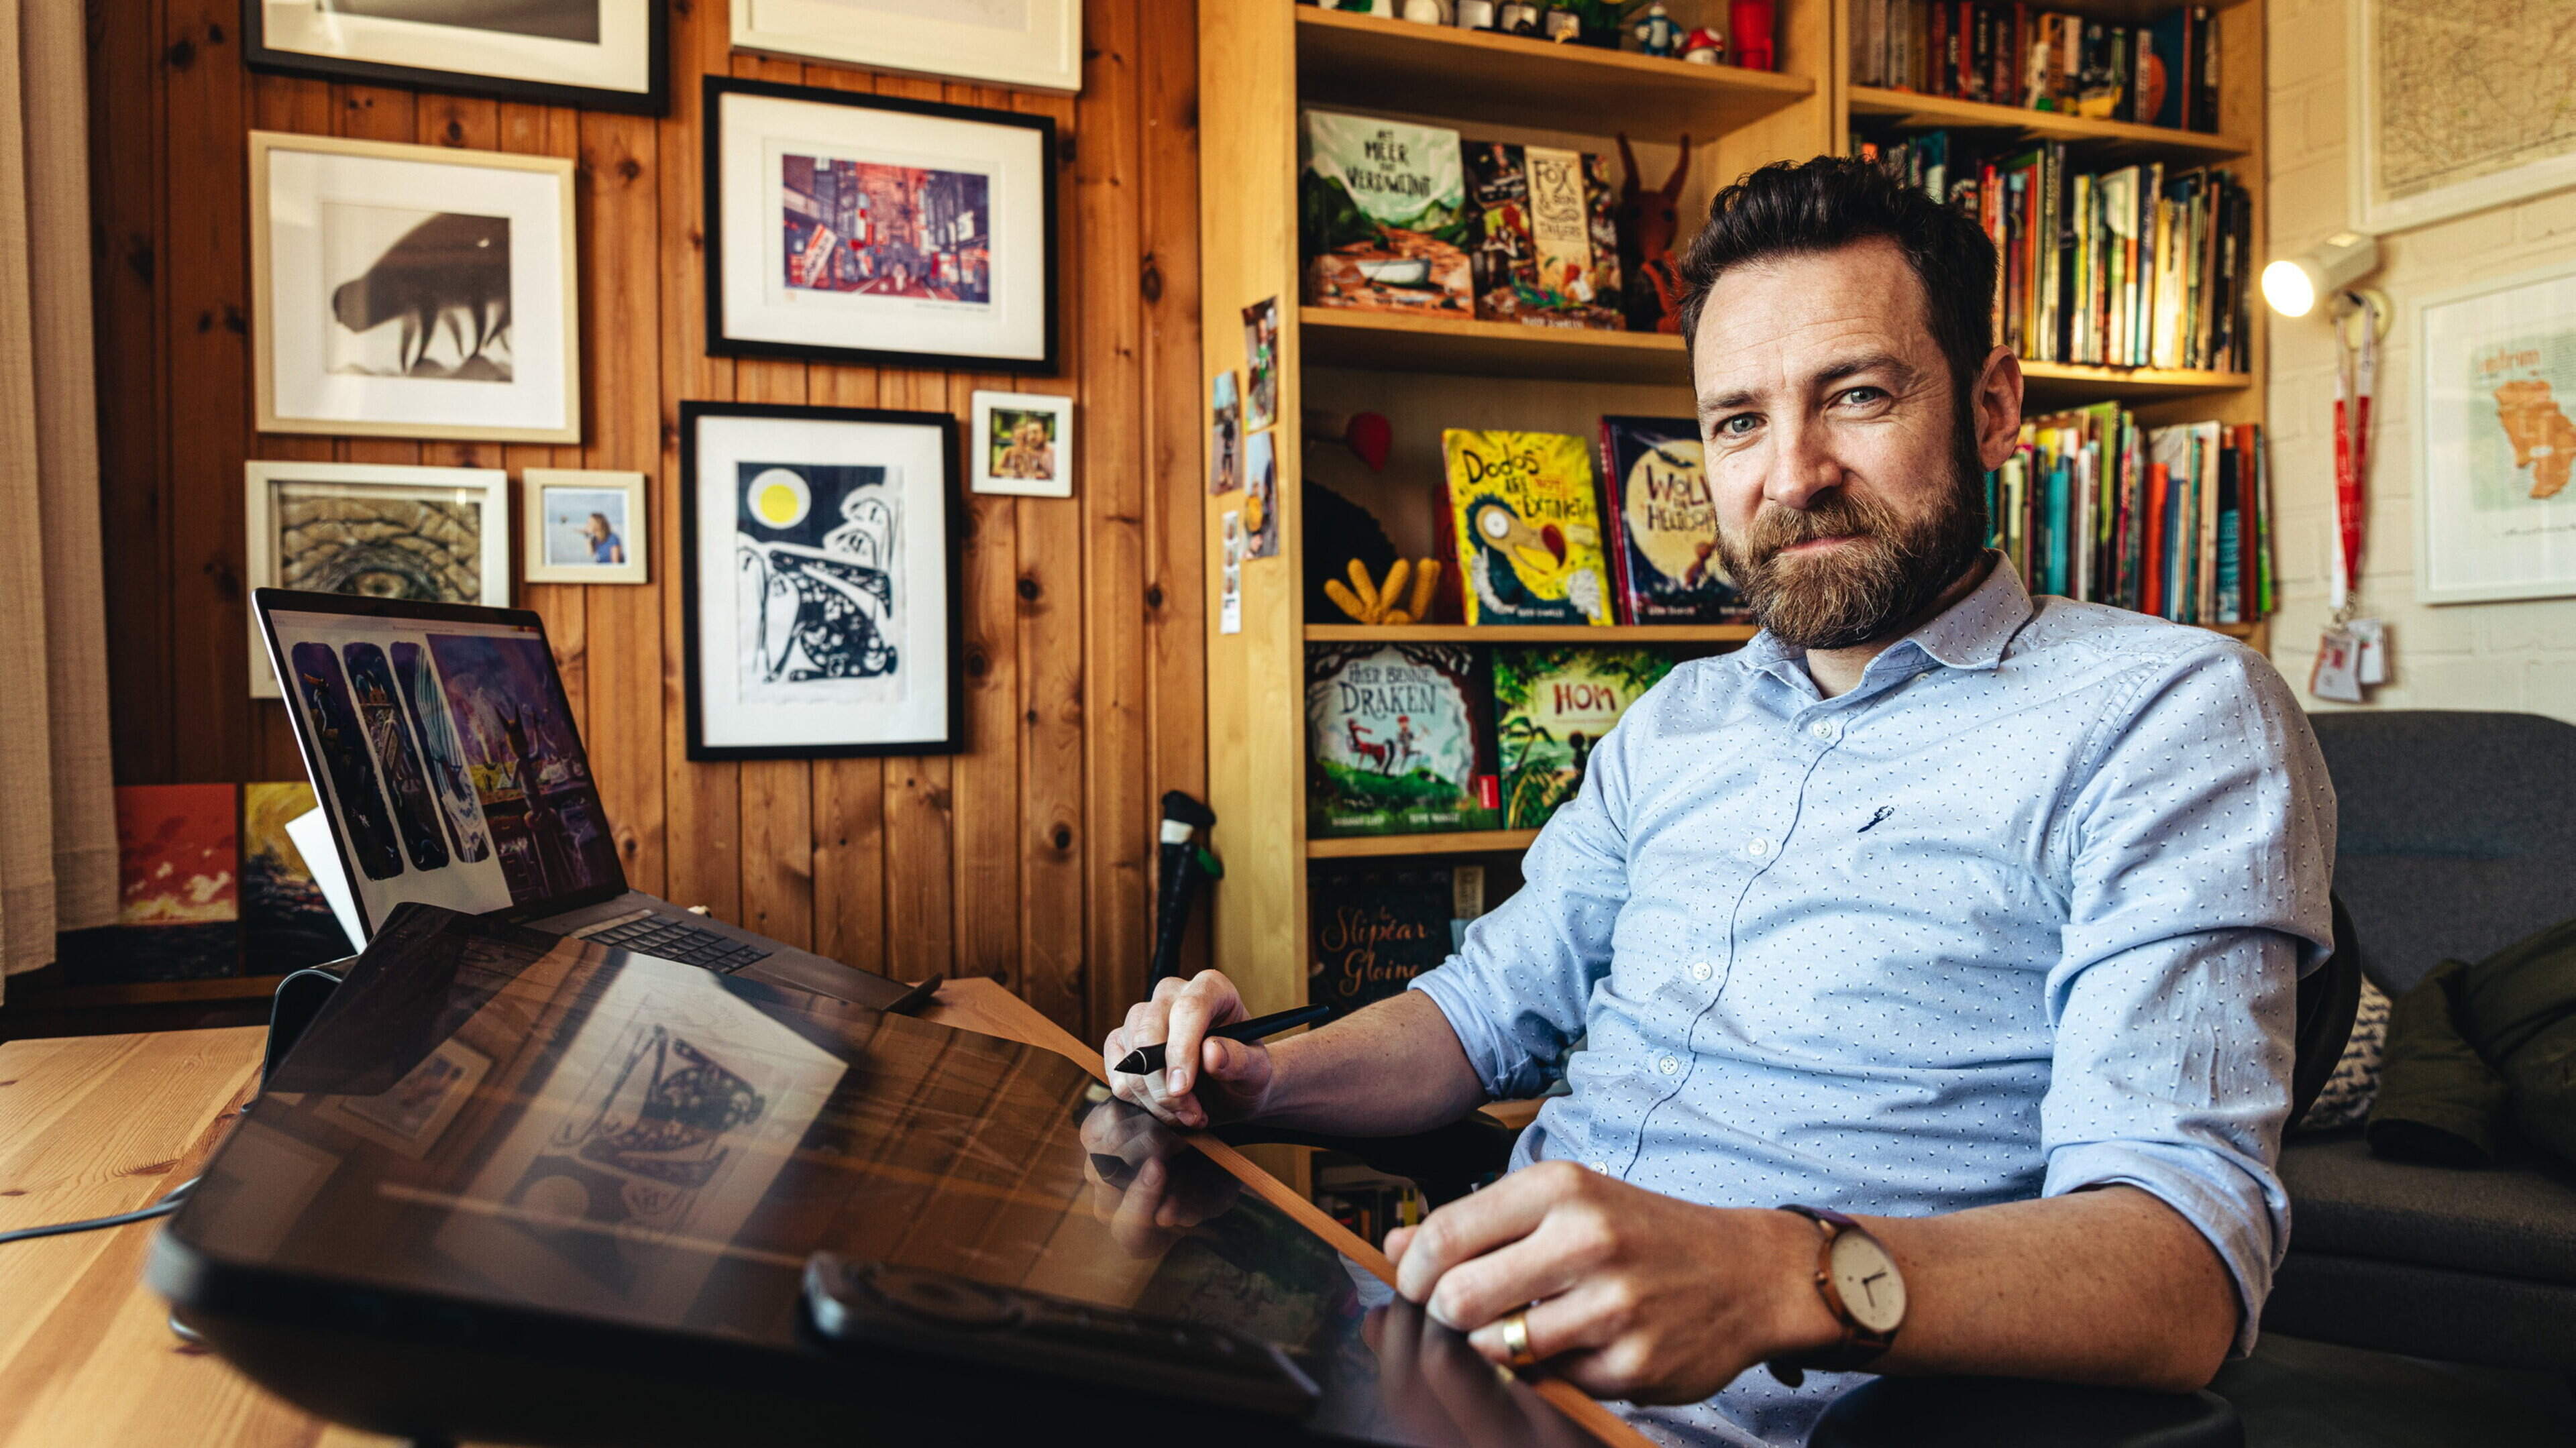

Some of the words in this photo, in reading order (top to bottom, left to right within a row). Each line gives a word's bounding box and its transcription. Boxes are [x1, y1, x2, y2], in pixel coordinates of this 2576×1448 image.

[1533, 159, 1577, 195] FOX
[1338, 681, 1436, 721] DRAKEN
[1554, 683, 1617, 715] HOM
